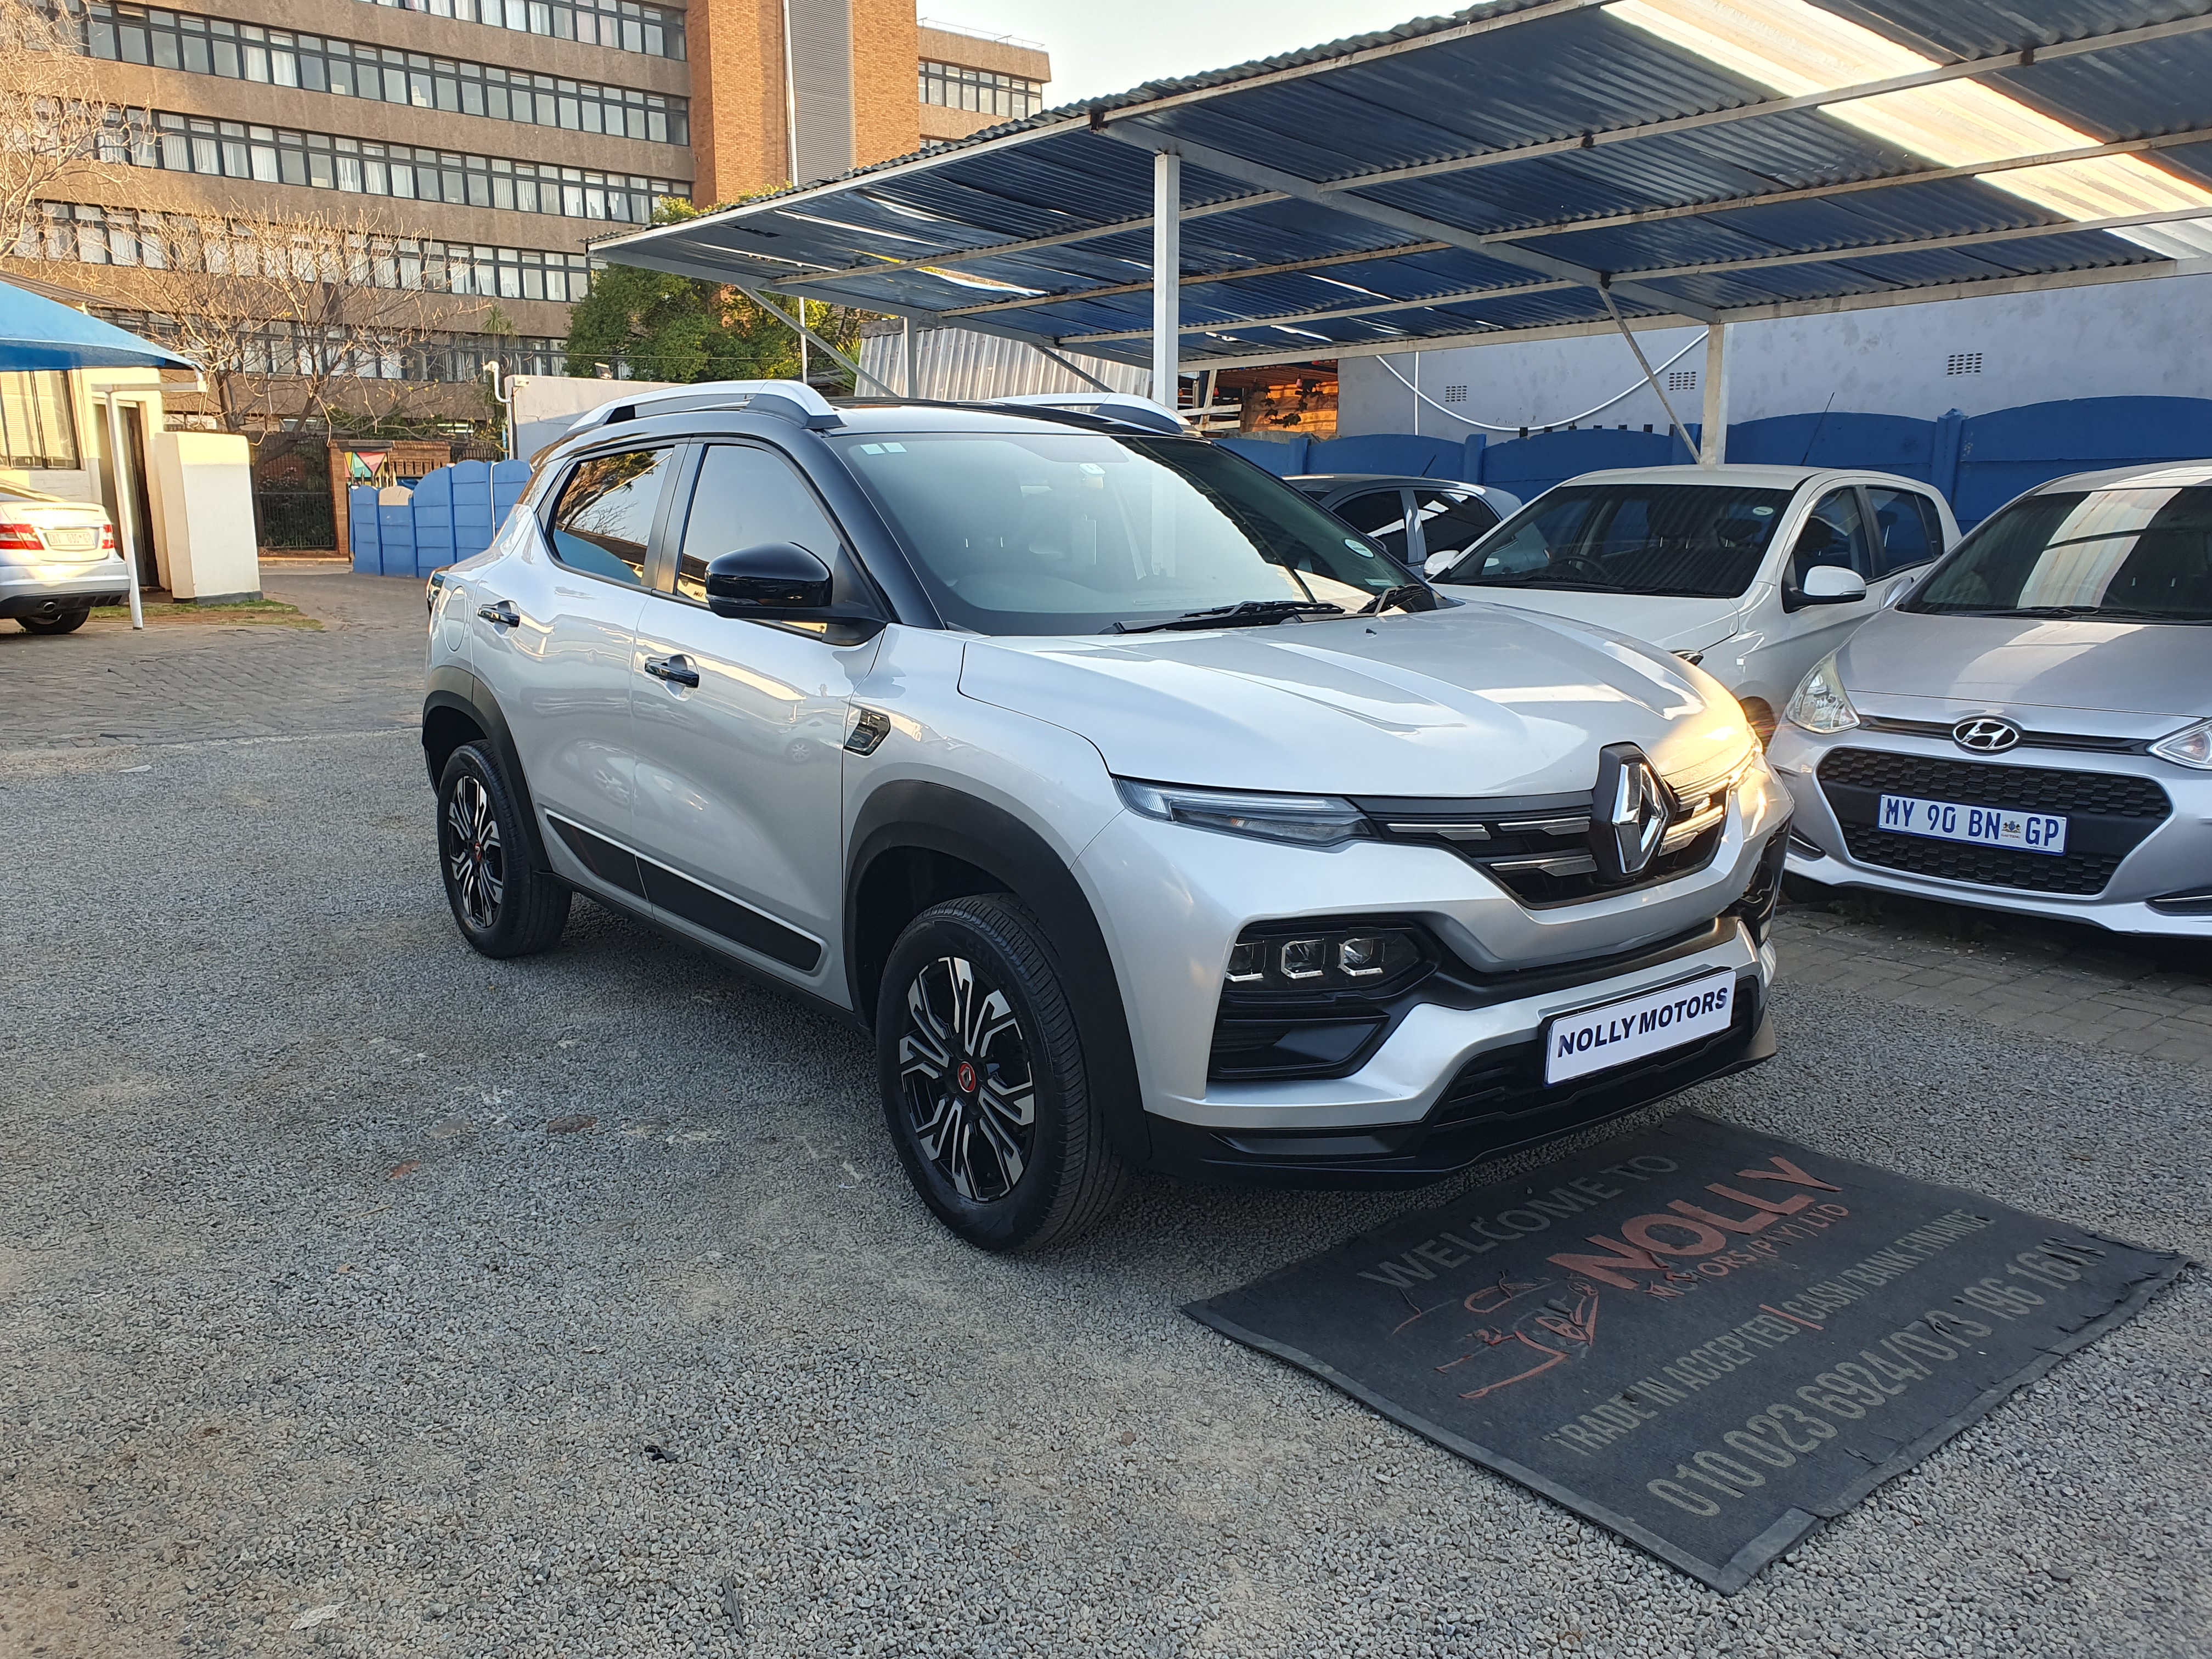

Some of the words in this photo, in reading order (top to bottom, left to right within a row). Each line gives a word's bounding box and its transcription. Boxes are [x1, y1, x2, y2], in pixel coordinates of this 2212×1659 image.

[1885, 798, 1915, 827] MY
[1927, 804, 1956, 833] 90
[1968, 809, 2001, 840] BN
[2025, 816, 2059, 847] GP
[1557, 1015, 1636, 1058] NOLLY
[1638, 987, 1728, 1034] MOTORS
[1357, 1177, 1623, 1288] WELCOME
[1598, 1155, 1679, 1181] TO
[1546, 1155, 1843, 1290] NOLLY
[1798, 1203, 1849, 1228] LTD
[1541, 1391, 1658, 1456] TRADE
[1626, 1376, 1689, 1407] IN
[1893, 1209, 1996, 1256] FINANCE
[1646, 1450, 1766, 1516] 010
[1723, 1403, 1838, 1468] 023
[1951, 1277, 2046, 1321] 196
